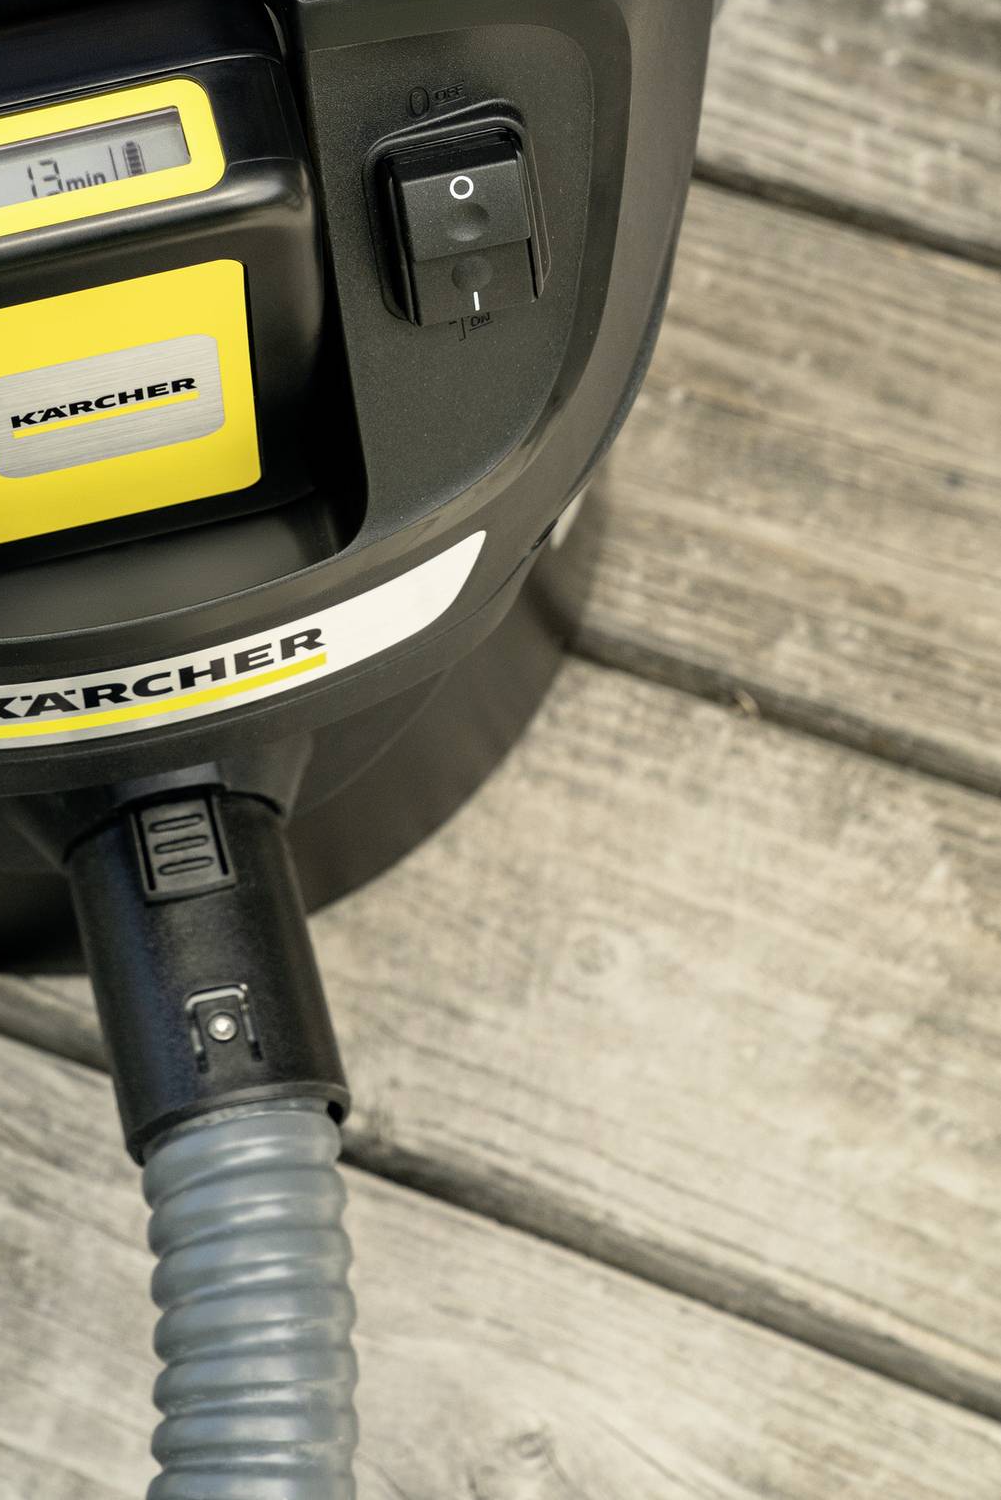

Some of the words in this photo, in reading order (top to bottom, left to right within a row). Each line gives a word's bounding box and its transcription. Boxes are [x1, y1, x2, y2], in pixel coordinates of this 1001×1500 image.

[435, 84, 464, 100] OFF
[470, 311, 490, 328] ON
[10, 376, 198, 429] KÄRCHER
